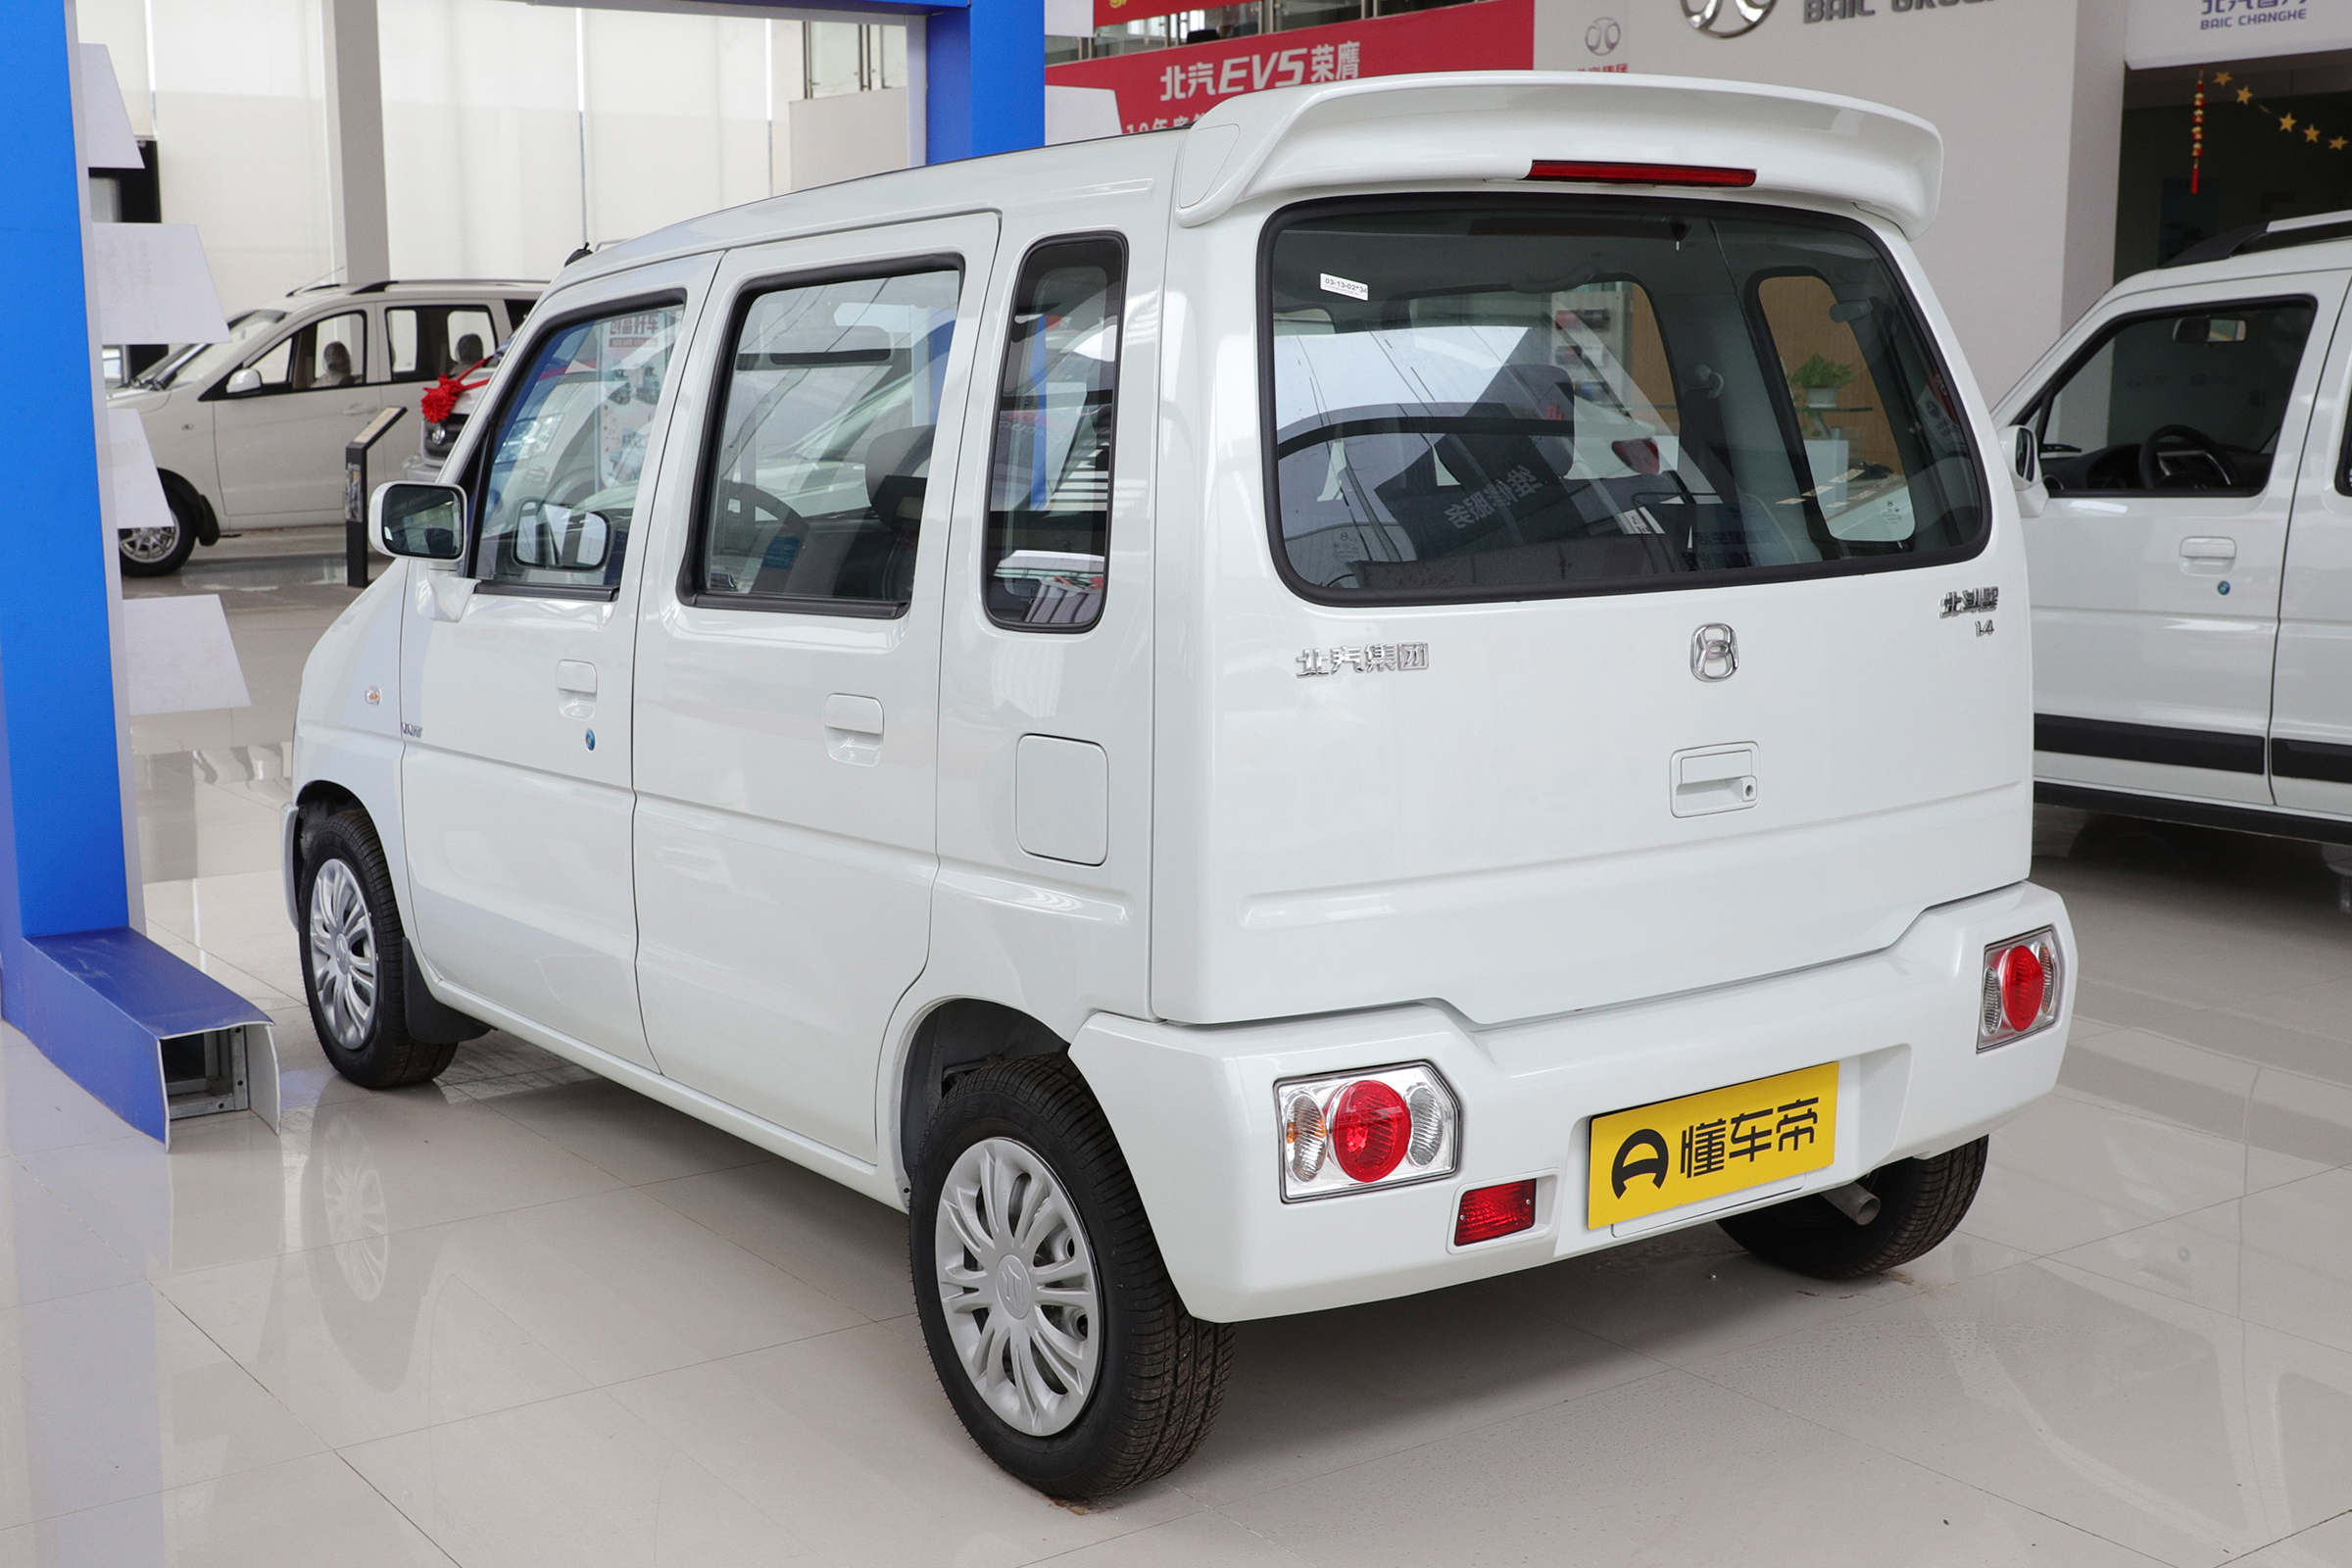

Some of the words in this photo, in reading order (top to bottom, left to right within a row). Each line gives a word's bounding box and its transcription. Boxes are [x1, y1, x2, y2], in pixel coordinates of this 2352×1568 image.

[2200, 17, 2233, 30] BAIC
[2238, 8, 2307, 26] CHANGHE
[1295, 642, 1430, 679] 北汽集团
[1680, 1097, 1820, 1179] 懂车帝
